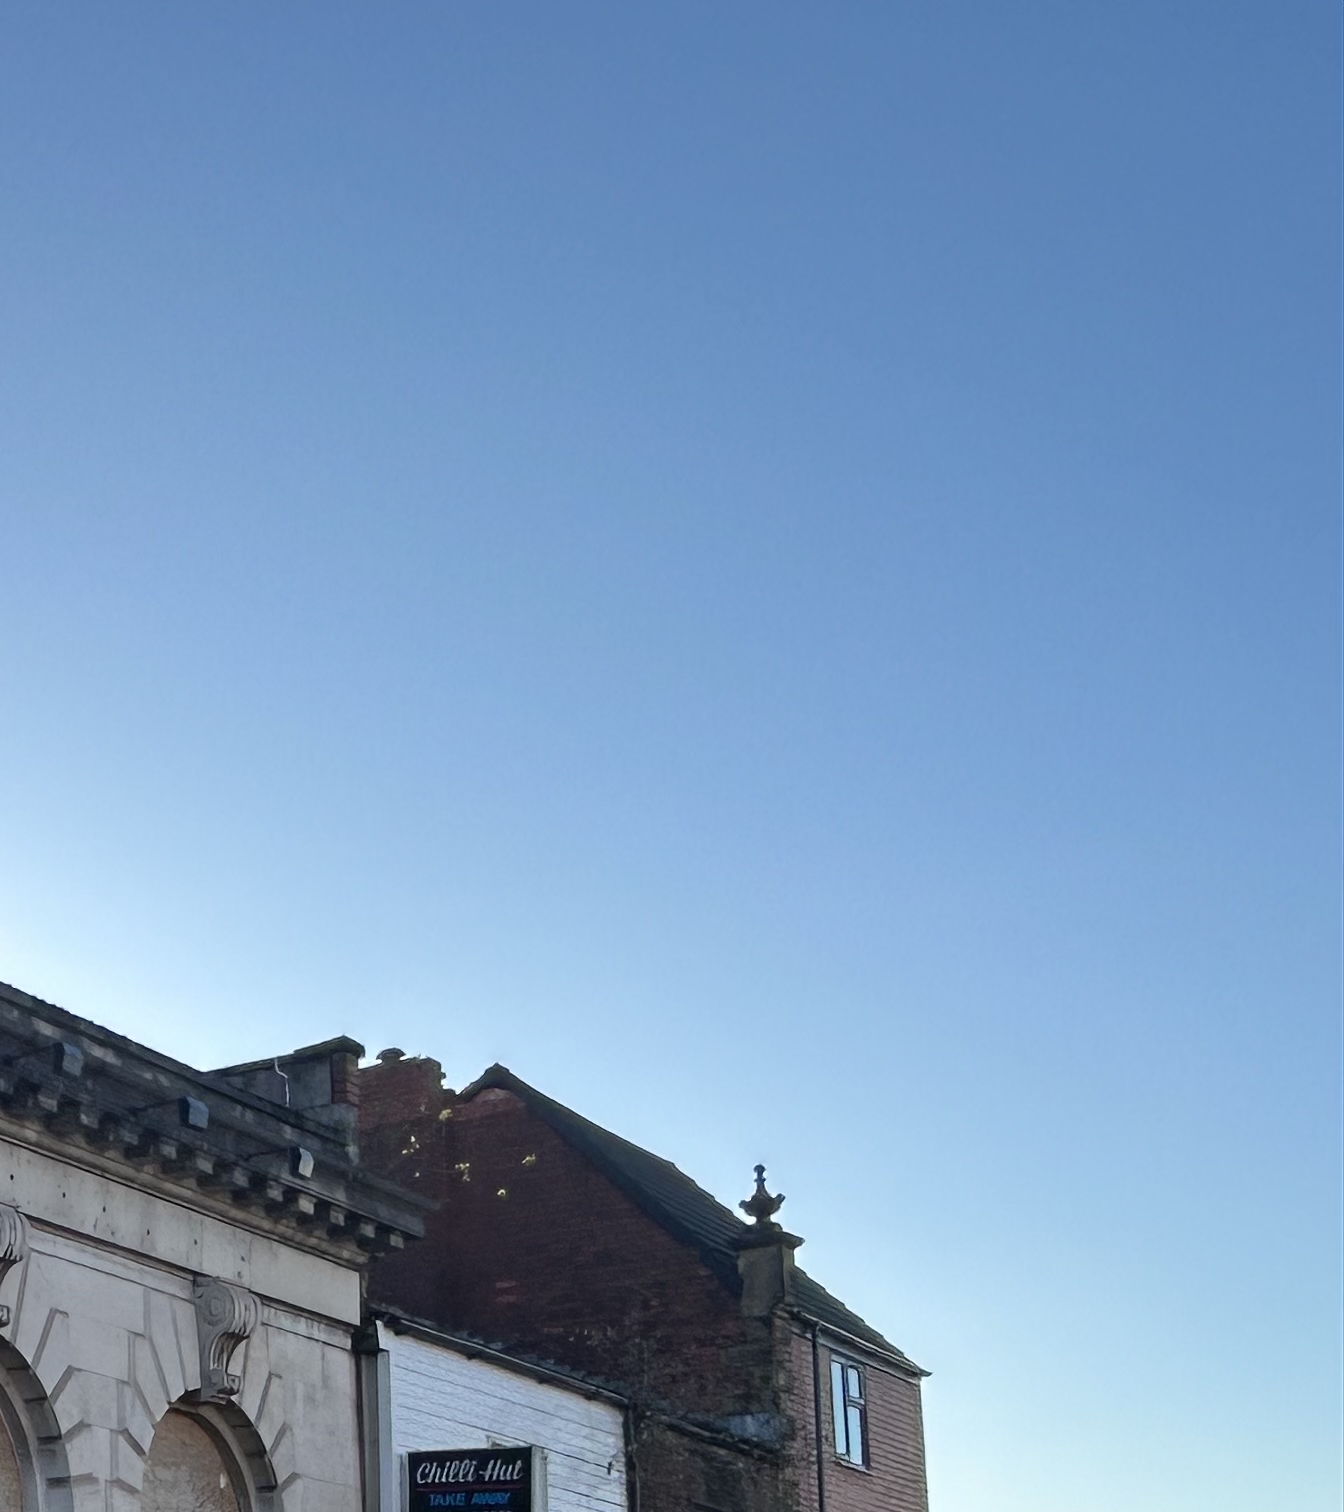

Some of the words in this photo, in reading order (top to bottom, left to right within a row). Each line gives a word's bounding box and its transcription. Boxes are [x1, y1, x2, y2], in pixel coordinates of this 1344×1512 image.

[416, 1459, 477, 1484] Chilli
[429, 1492, 466, 1506] TAKE
[472, 1490, 511, 1505] AWAY
